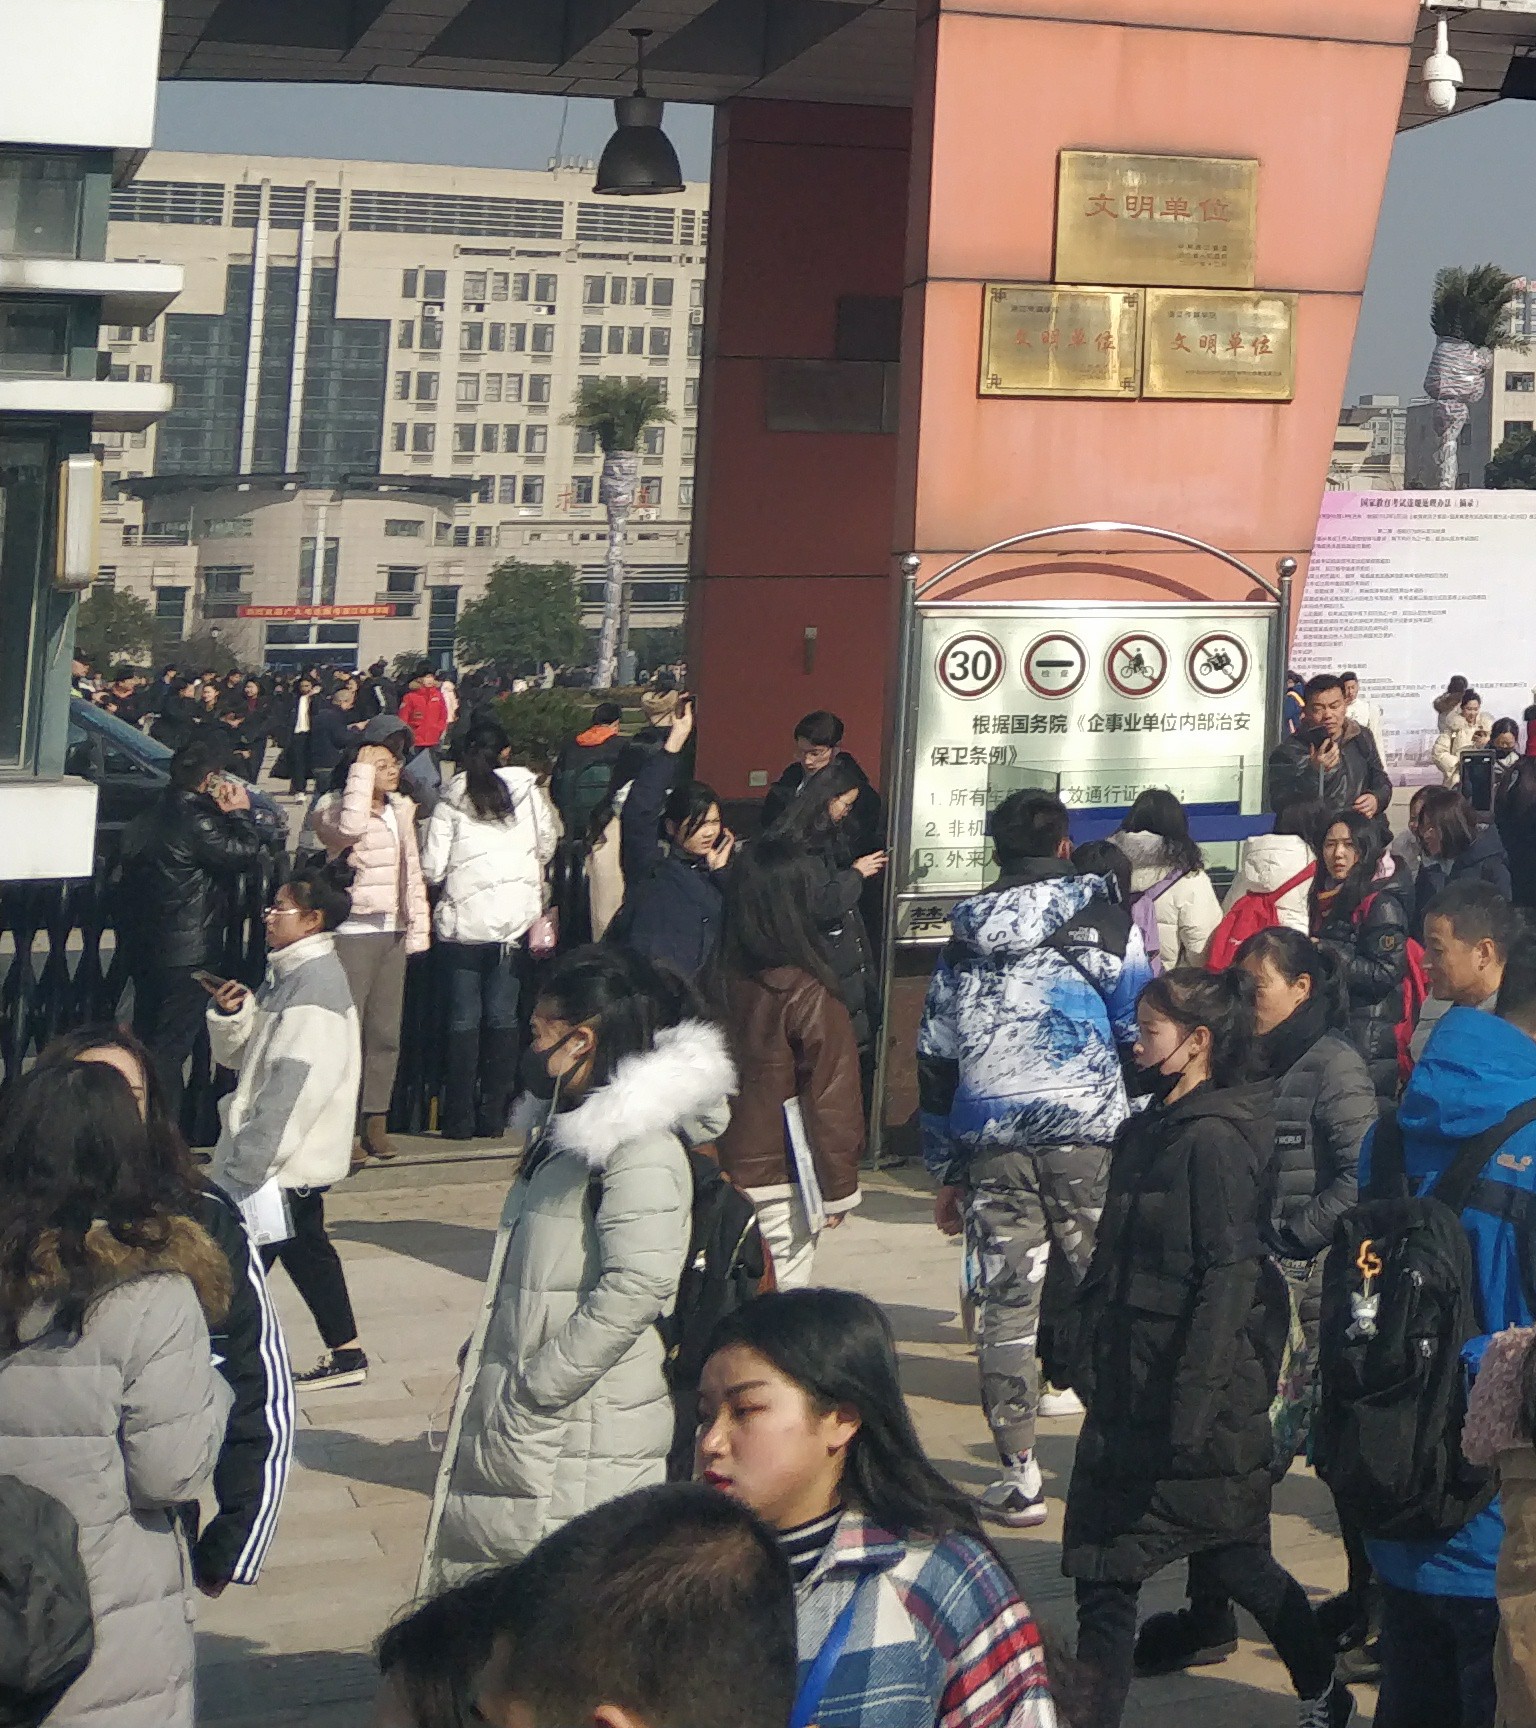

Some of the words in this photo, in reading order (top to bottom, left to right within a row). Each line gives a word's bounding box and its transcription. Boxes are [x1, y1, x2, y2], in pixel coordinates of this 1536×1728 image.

[1085, 193, 1231, 222] 文明单位
[1015, 327, 1116, 353] 文明单位
[1171, 331, 1274, 357] 文明单位
[949, 649, 993, 682] 30
[971, 712, 1251, 735] 根据国务院《企事业单位内部治安
[930, 745, 1019, 767] 保卫条例》
[925, 821, 941, 838] 2.
[924, 852, 939, 869] 3.
